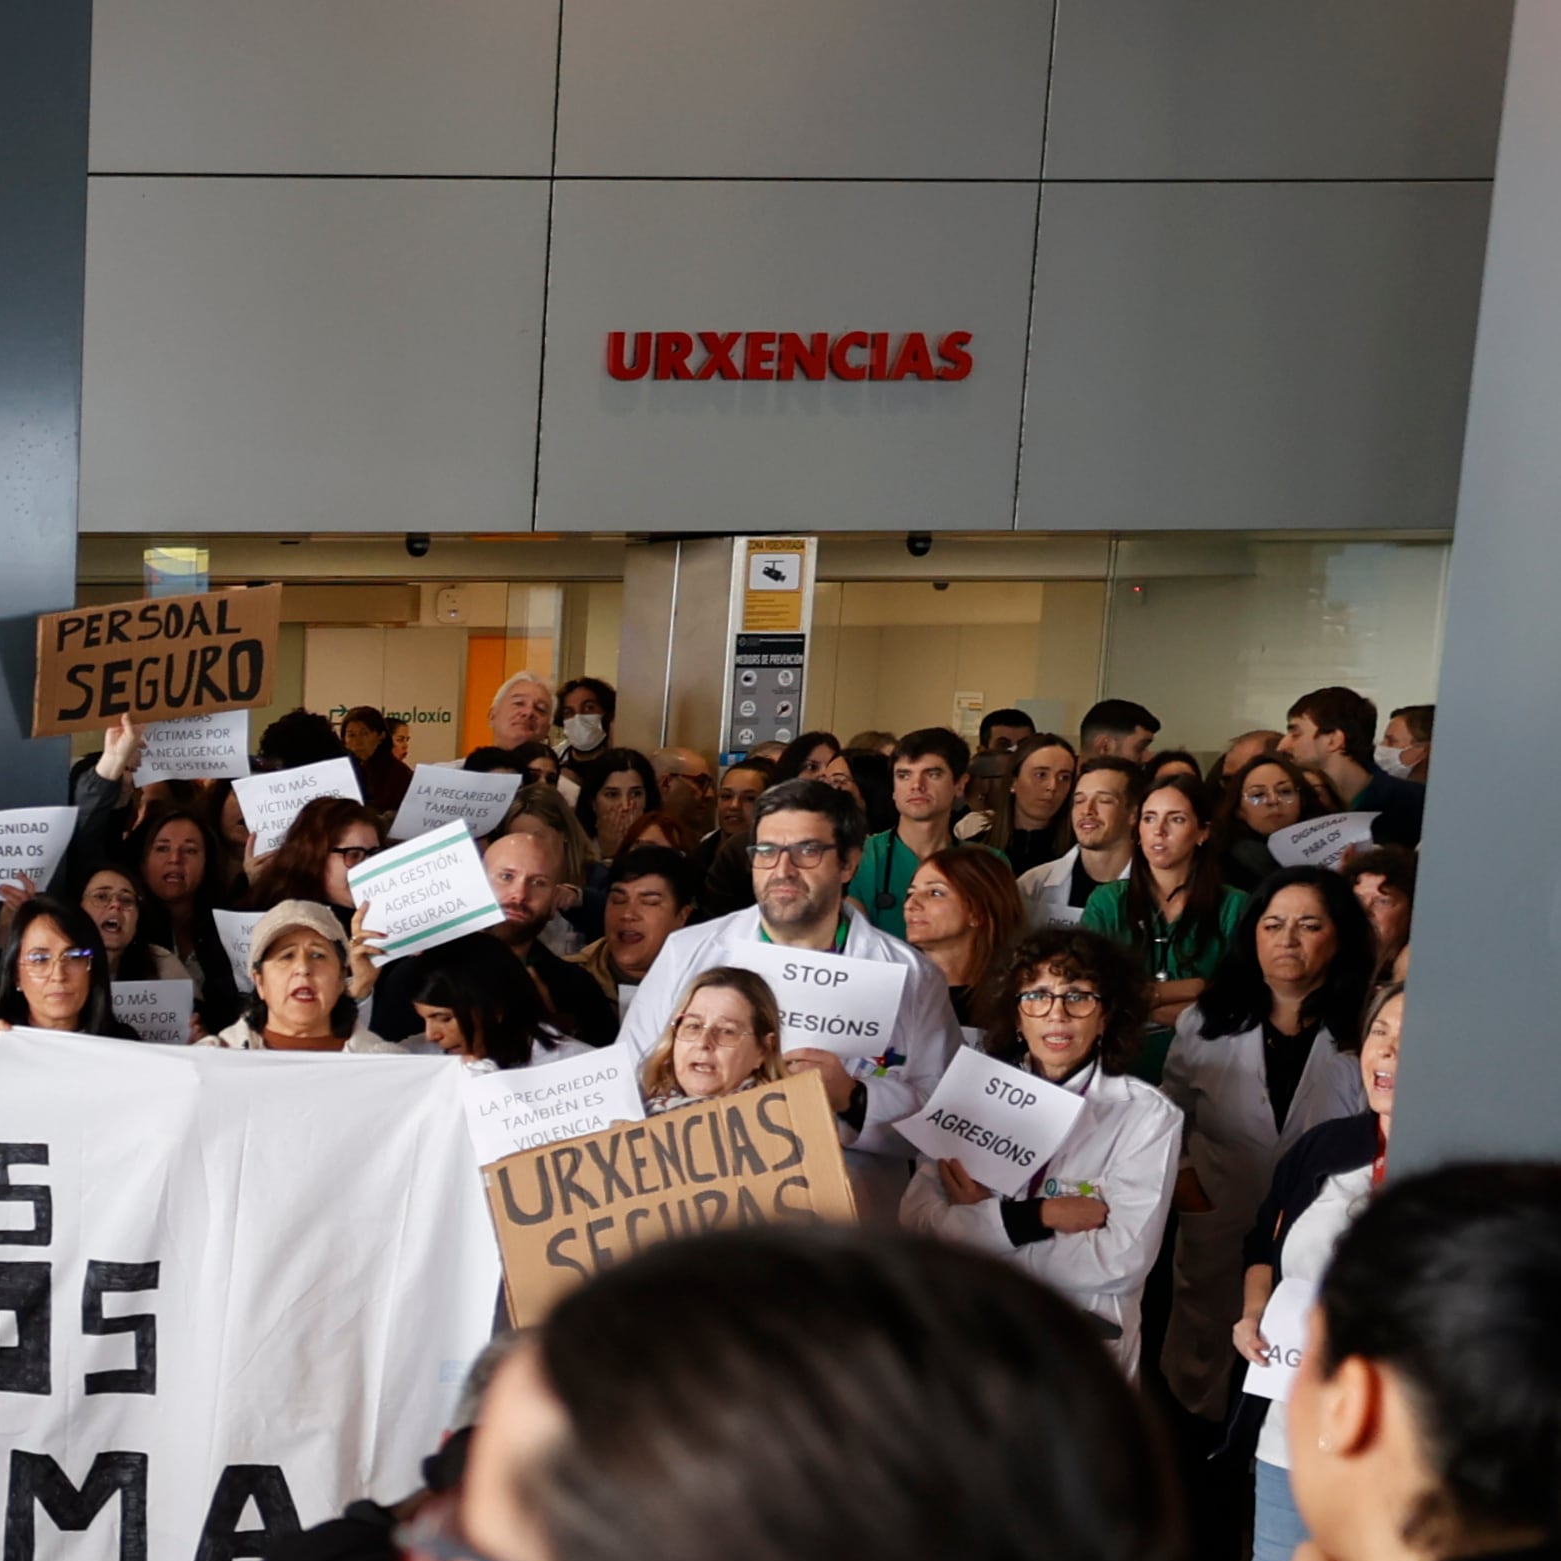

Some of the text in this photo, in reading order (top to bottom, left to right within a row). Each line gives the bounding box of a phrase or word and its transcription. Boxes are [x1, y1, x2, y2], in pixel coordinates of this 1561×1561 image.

[607, 331, 974, 381] URXENCIAS
[57, 599, 242, 652] PERSOAL
[57, 638, 264, 721] SEGURO
[145, 727, 230, 741] VÍCTIMAS POR
[158, 745, 236, 758] NEGLIGENCIA
[152, 761, 228, 771] DEL SISTEMA
[269, 775, 318, 795] NO MÁS
[417, 785, 507, 802] LA PRECARIEDAD
[424, 801, 489, 818] TAMBIÉN ES
[26, 845, 44, 857] OS
[361, 877, 398, 901] MALA
[384, 878, 452, 916] AGRESIÓN
[385, 898, 468, 936] ASEGURADA
[782, 963, 849, 987] STOP
[128, 989, 157, 1005] MÁS
[150, 1012, 176, 1023] POR
[778, 1011, 880, 1037] RESIÓNS
[479, 1067, 619, 1117] LA PRECARIEDAD
[984, 1077, 1037, 1109] STOP
[502, 1091, 605, 1131] TAMBIÉN ES
[513, 1115, 604, 1151] VIOLENCIA
[926, 1108, 1036, 1167] AGRESIÓNS
[497, 1091, 805, 1226] URXENCIAS
